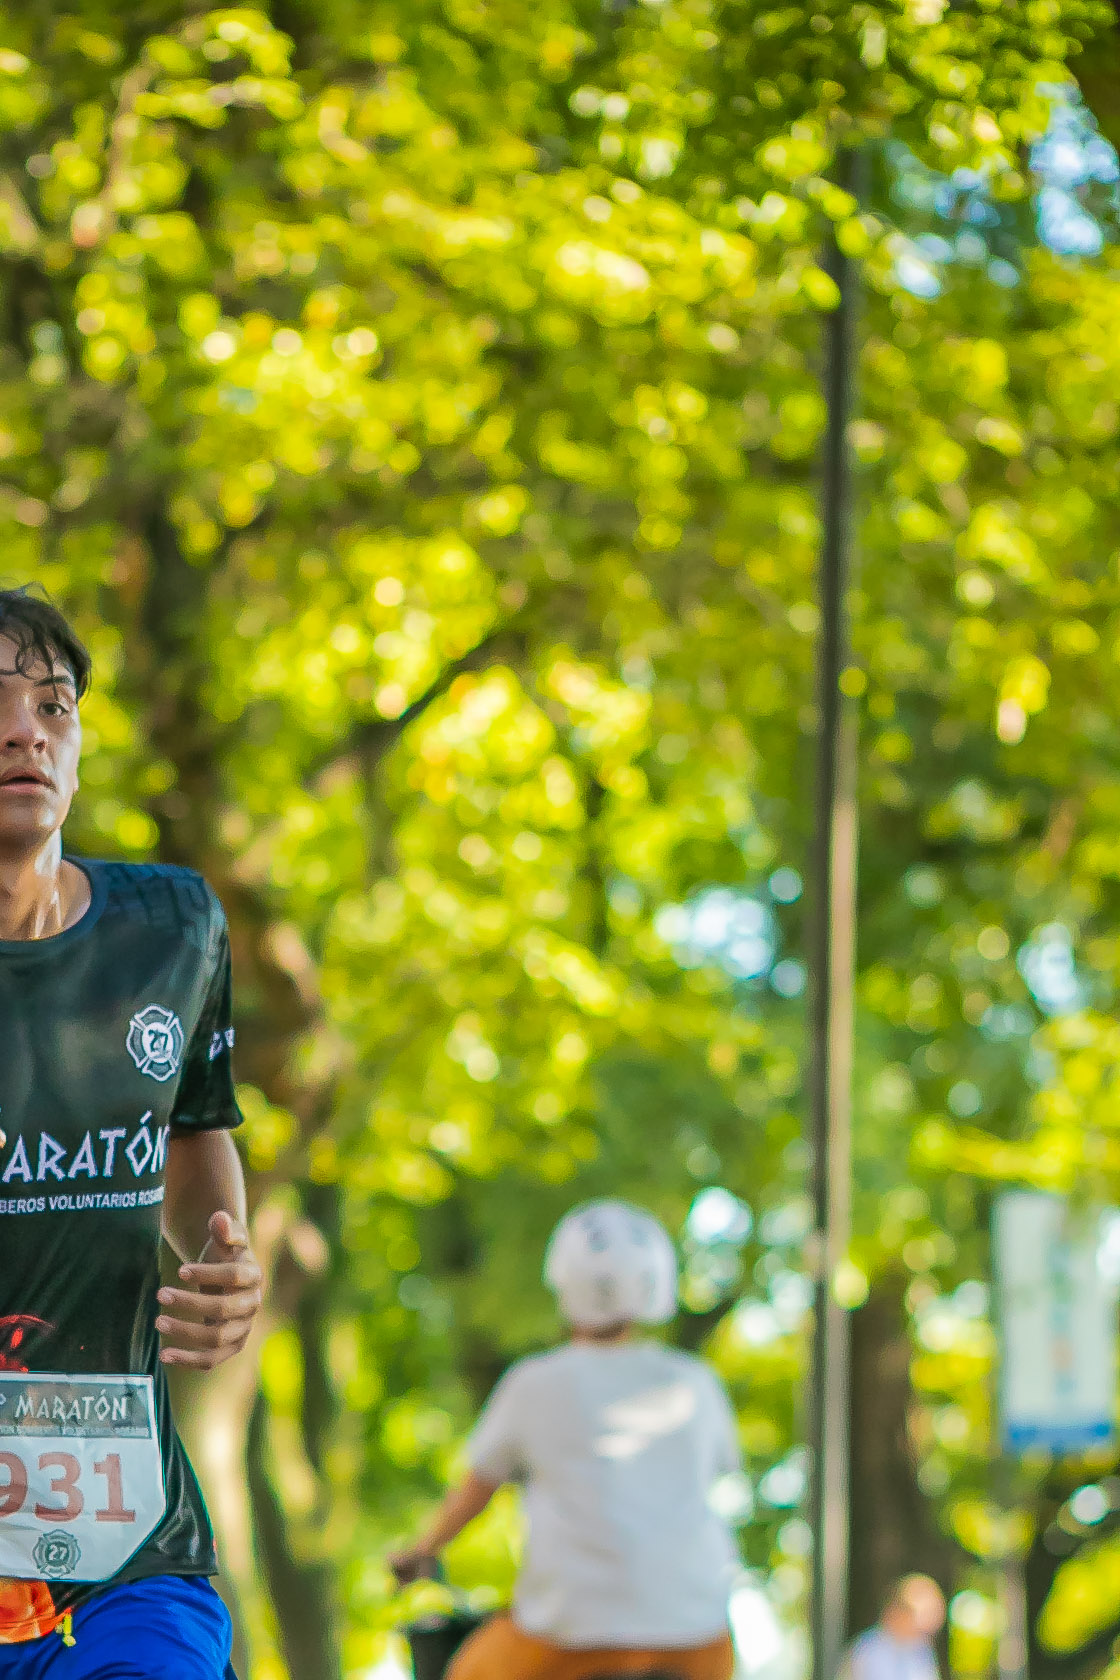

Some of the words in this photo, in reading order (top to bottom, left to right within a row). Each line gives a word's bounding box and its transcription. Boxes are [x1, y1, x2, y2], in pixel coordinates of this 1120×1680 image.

[48, 1191, 138, 1211] VOLUNTARIOS
[14, 1388, 128, 1422] MARATÓN
[48, 1543, 68, 1562] 27
